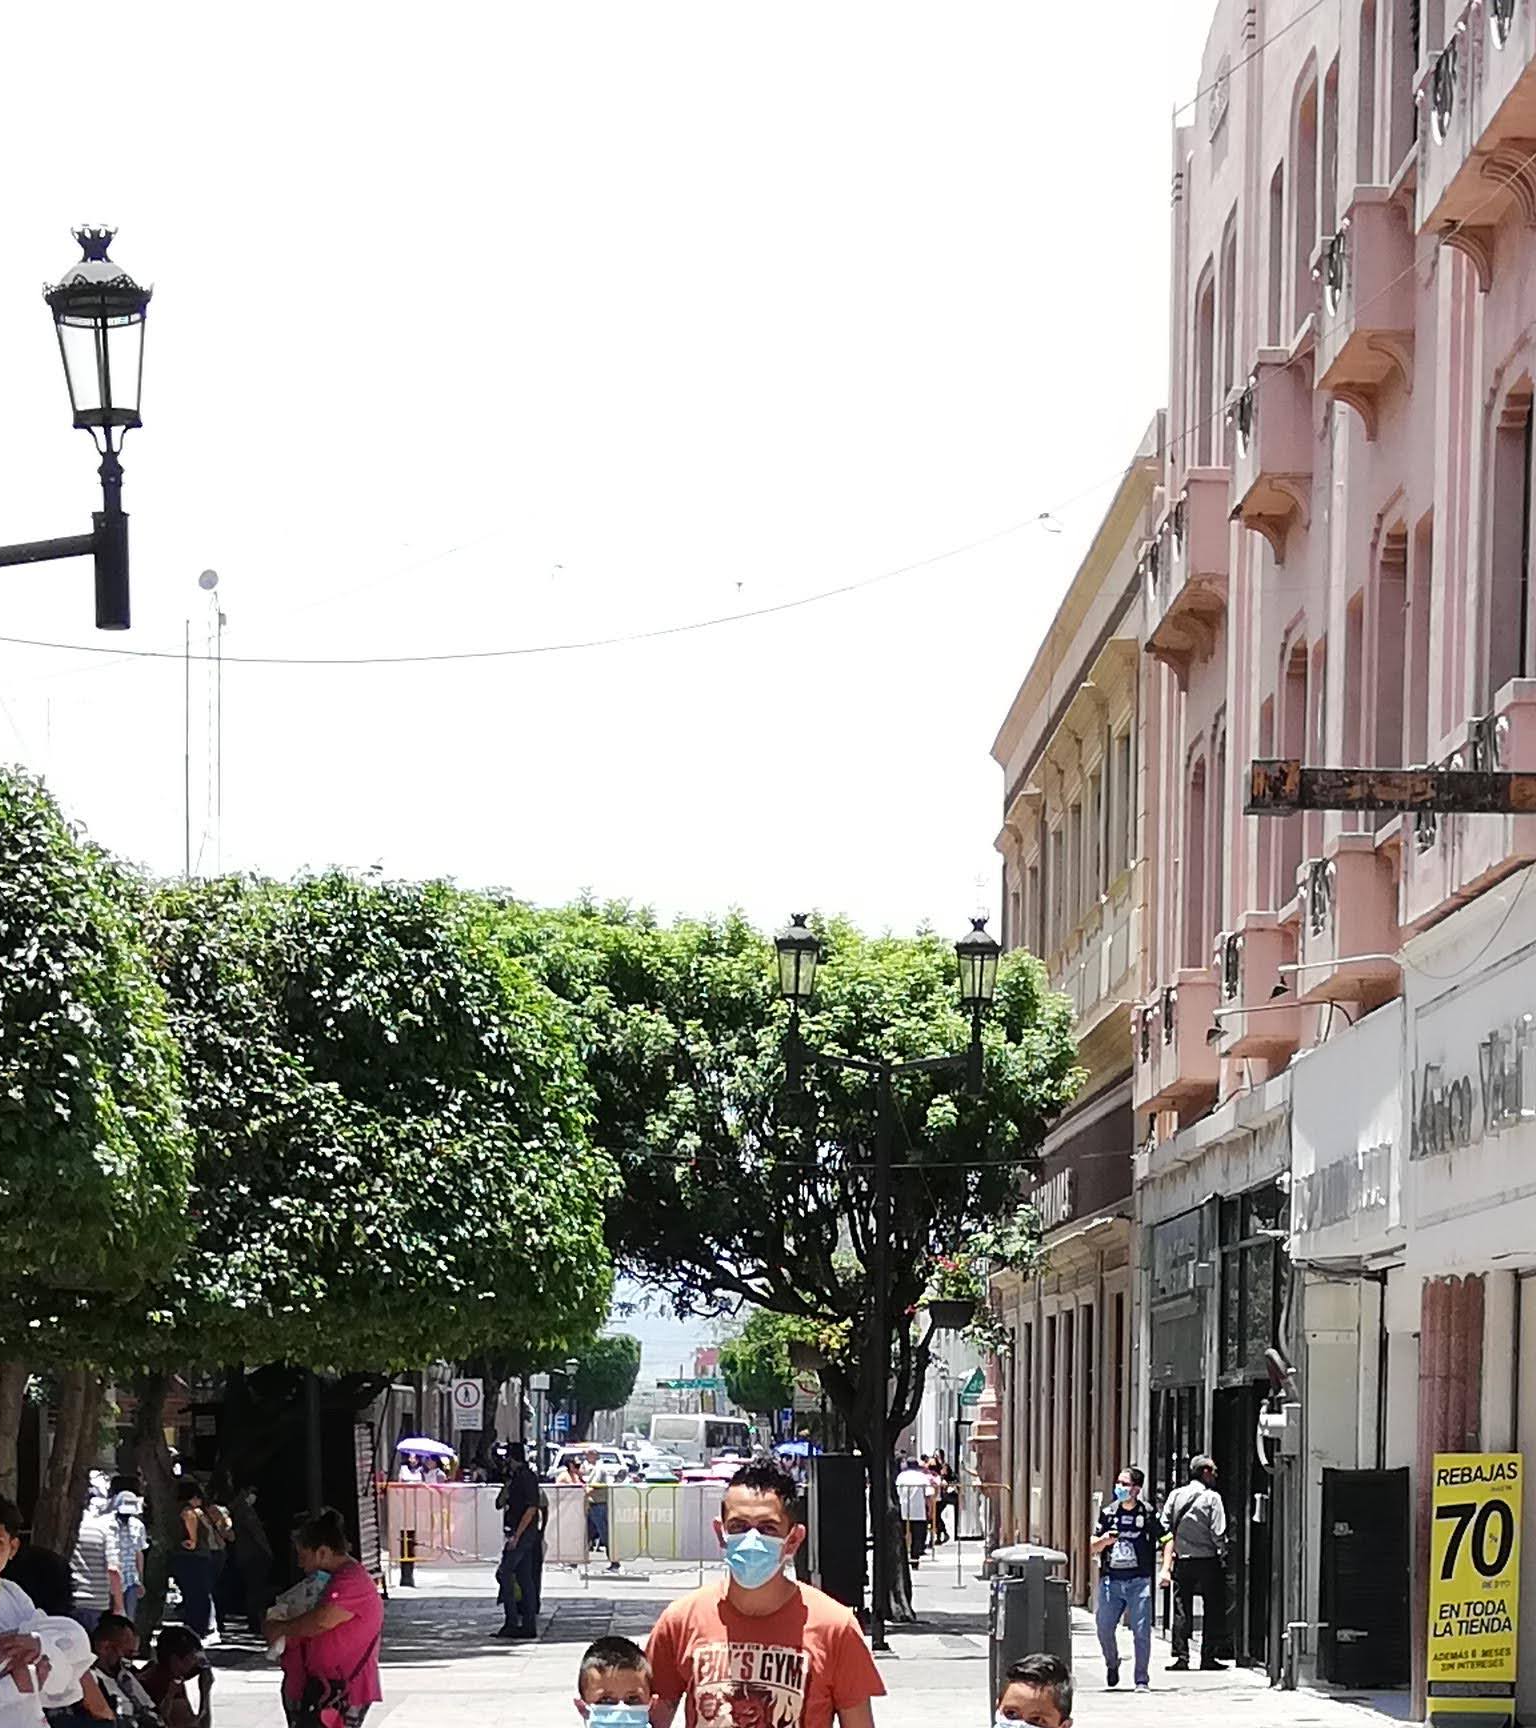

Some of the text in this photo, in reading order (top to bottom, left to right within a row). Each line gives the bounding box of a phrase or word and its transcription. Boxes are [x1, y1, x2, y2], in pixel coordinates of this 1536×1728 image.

[1437, 1462, 1518, 1487] REBAJAS
[1435, 1499, 1514, 1580] 70
[1439, 1599, 1507, 1620] EN TODA
[1433, 1616, 1512, 1638] LA TIENDA
[760, 1652, 805, 1690] GYM
